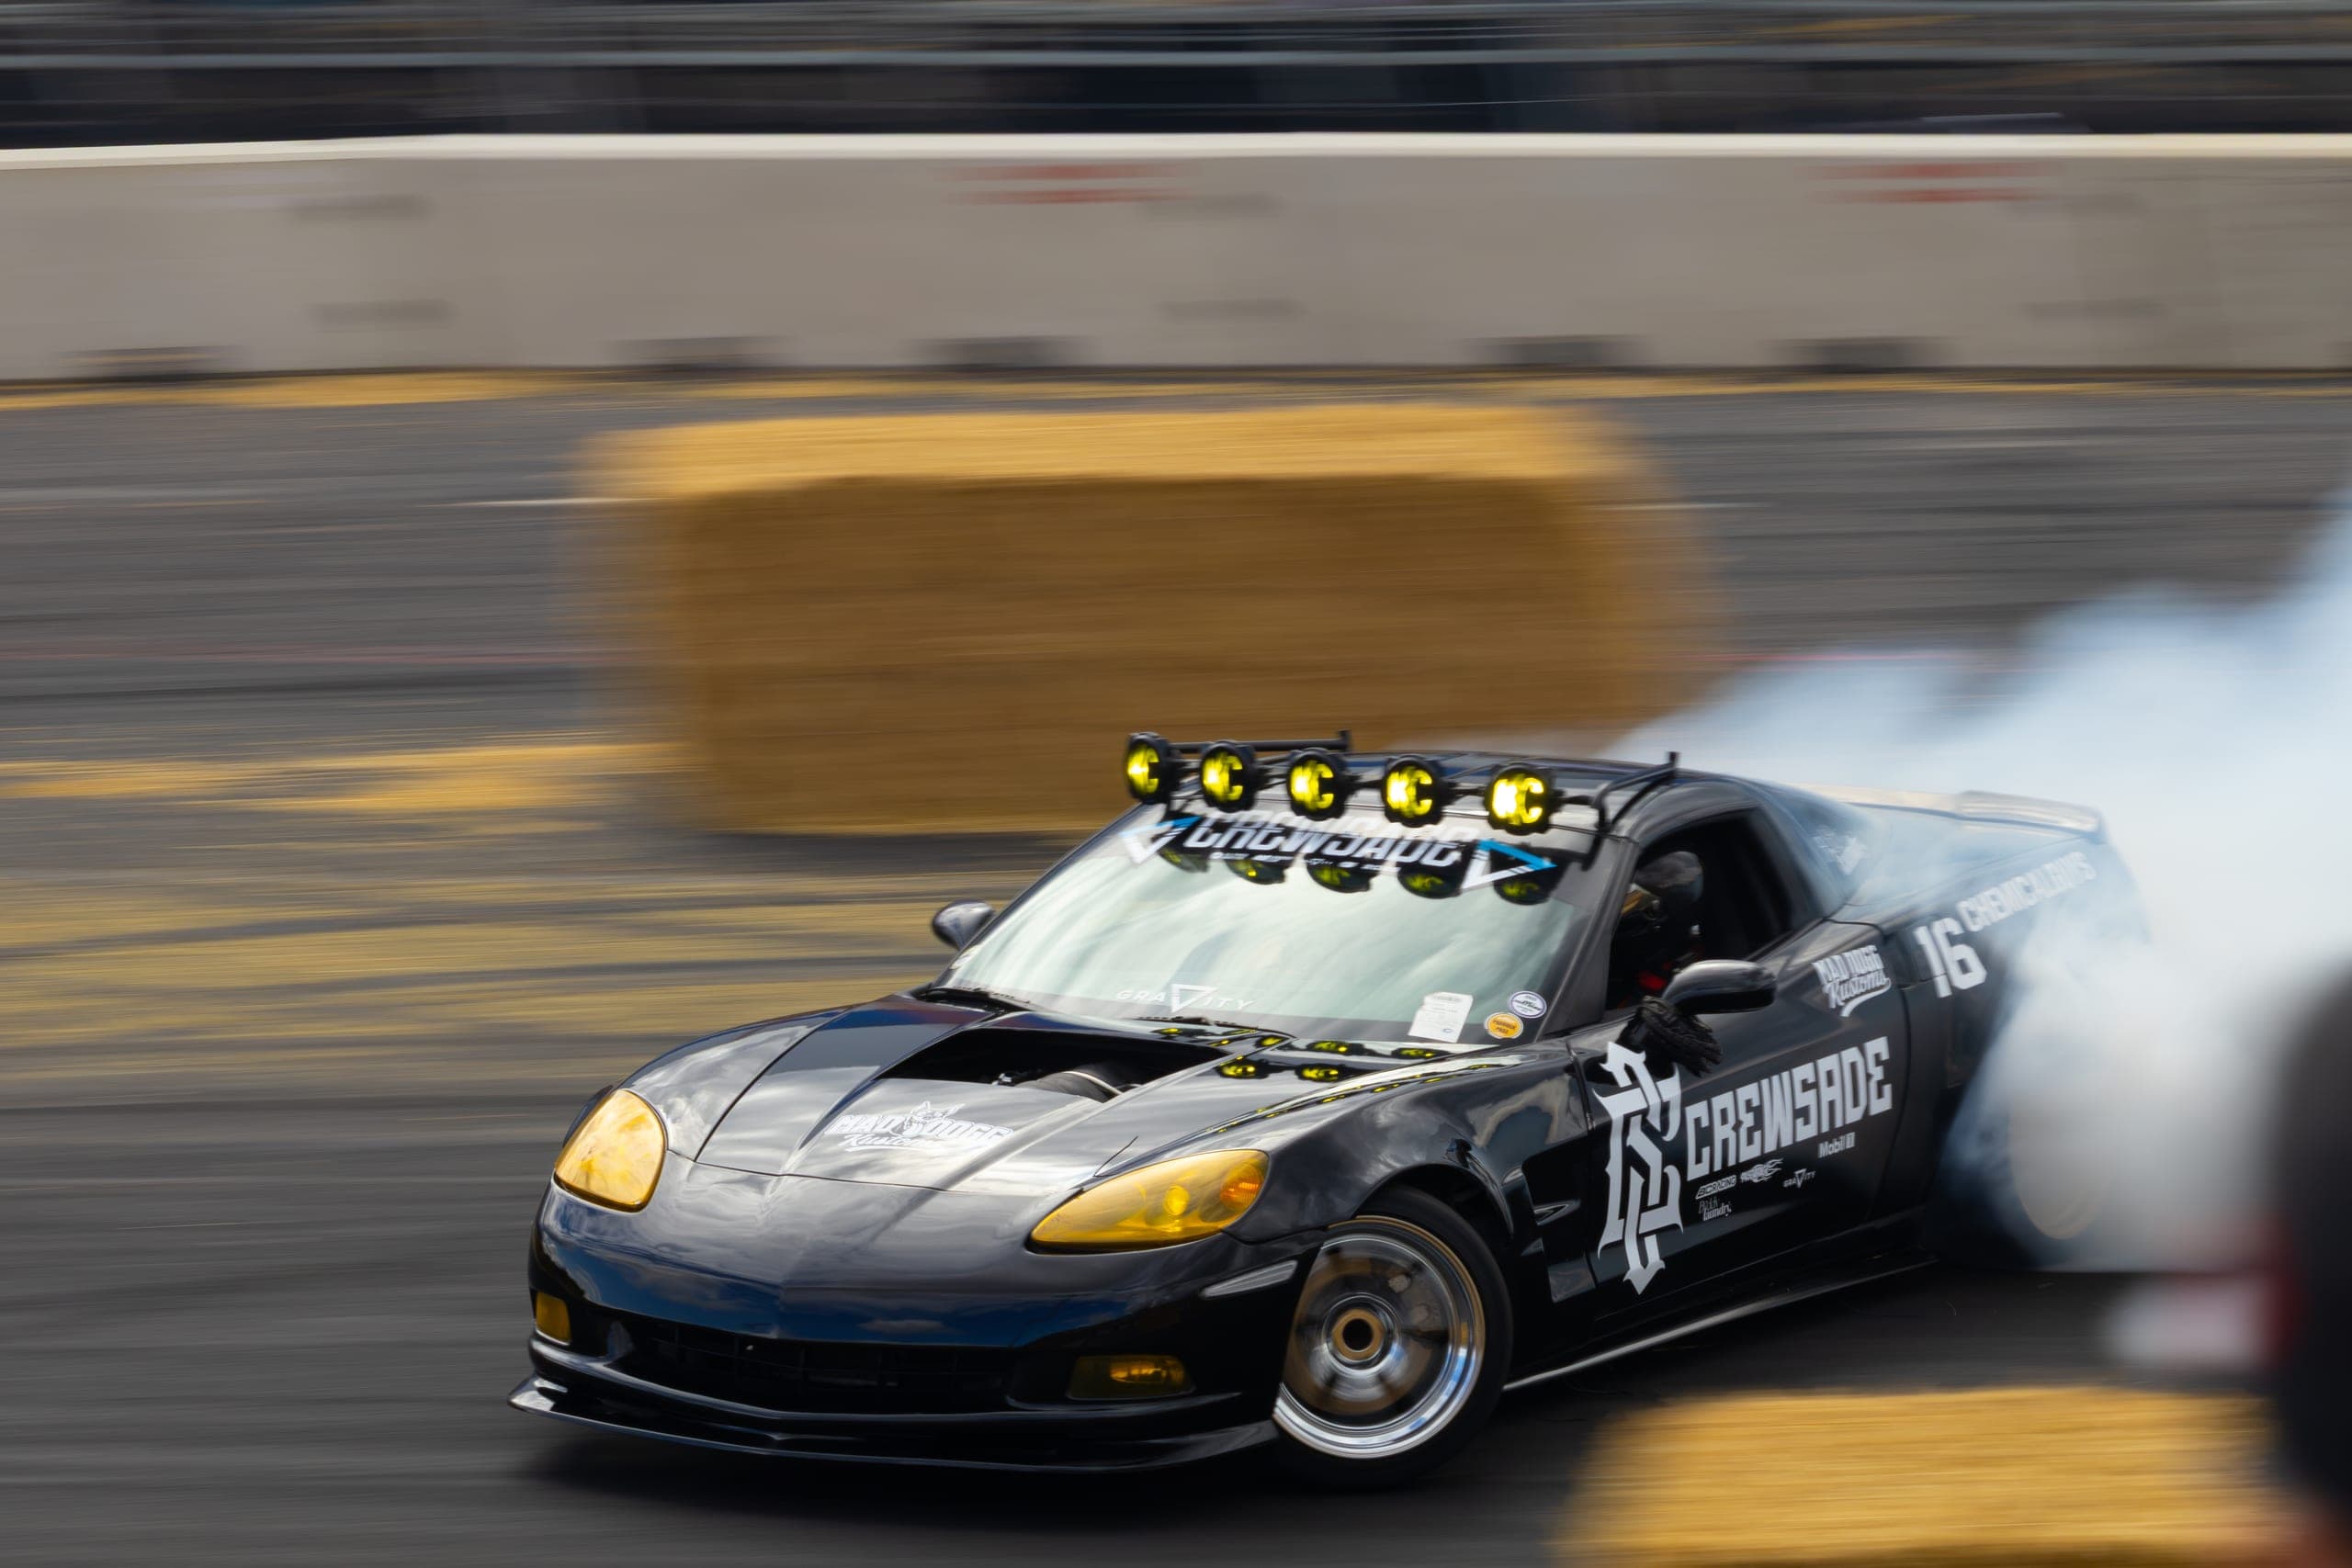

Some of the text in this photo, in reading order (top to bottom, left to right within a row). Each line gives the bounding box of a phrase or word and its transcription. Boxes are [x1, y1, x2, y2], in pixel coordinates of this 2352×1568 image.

[1914, 918, 1987, 998] 16
[1115, 983, 1257, 1013] GRAVITY
[1686, 1036, 1893, 1181] CREWSADE
[825, 1114, 906, 1134] MAD
[1818, 1135, 1846, 1158] Mobil
